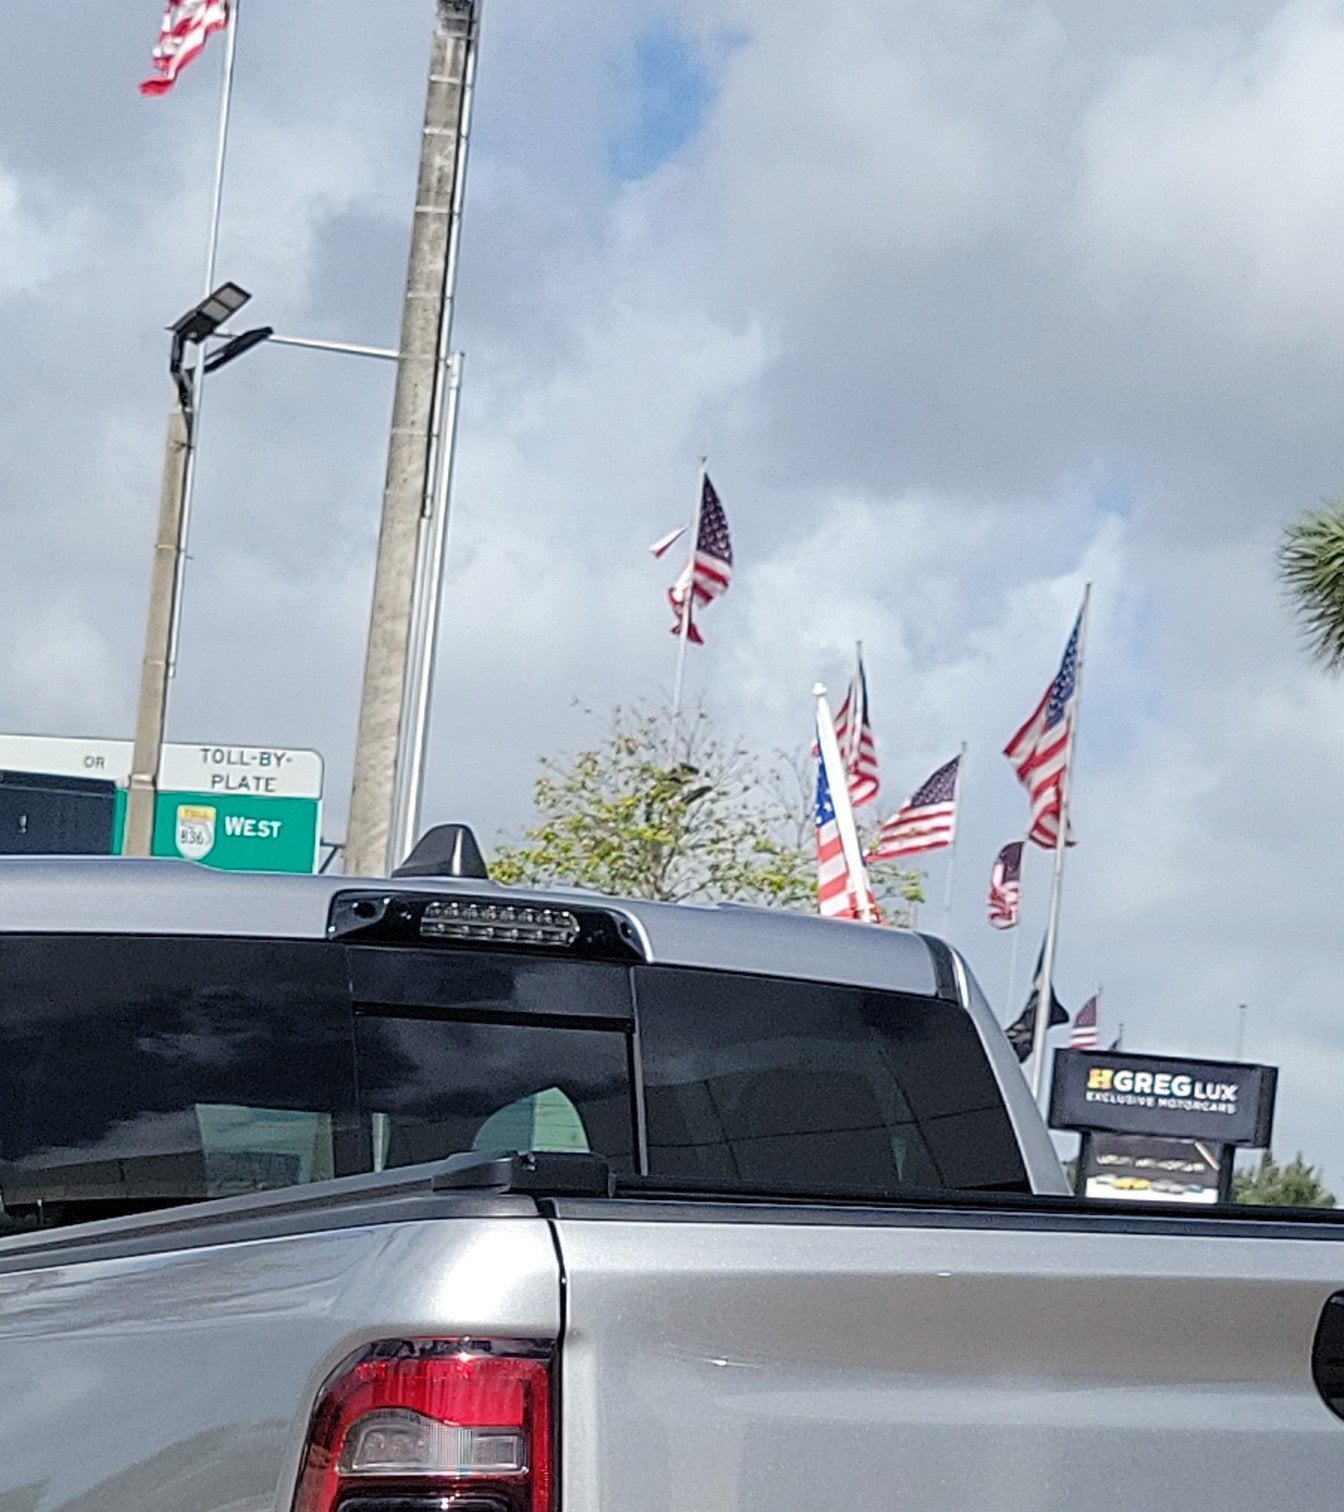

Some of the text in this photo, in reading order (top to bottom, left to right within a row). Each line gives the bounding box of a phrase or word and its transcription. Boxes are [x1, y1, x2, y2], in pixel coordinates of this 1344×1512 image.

[83, 755, 106, 770] OR
[200, 748, 292, 767] TOLL-BY-
[211, 774, 277, 792] PLATE
[224, 816, 282, 839] WEST
[1085, 1090, 1155, 1108] EXCLUSIVE
[1194, 1081, 1239, 1102] LUX
